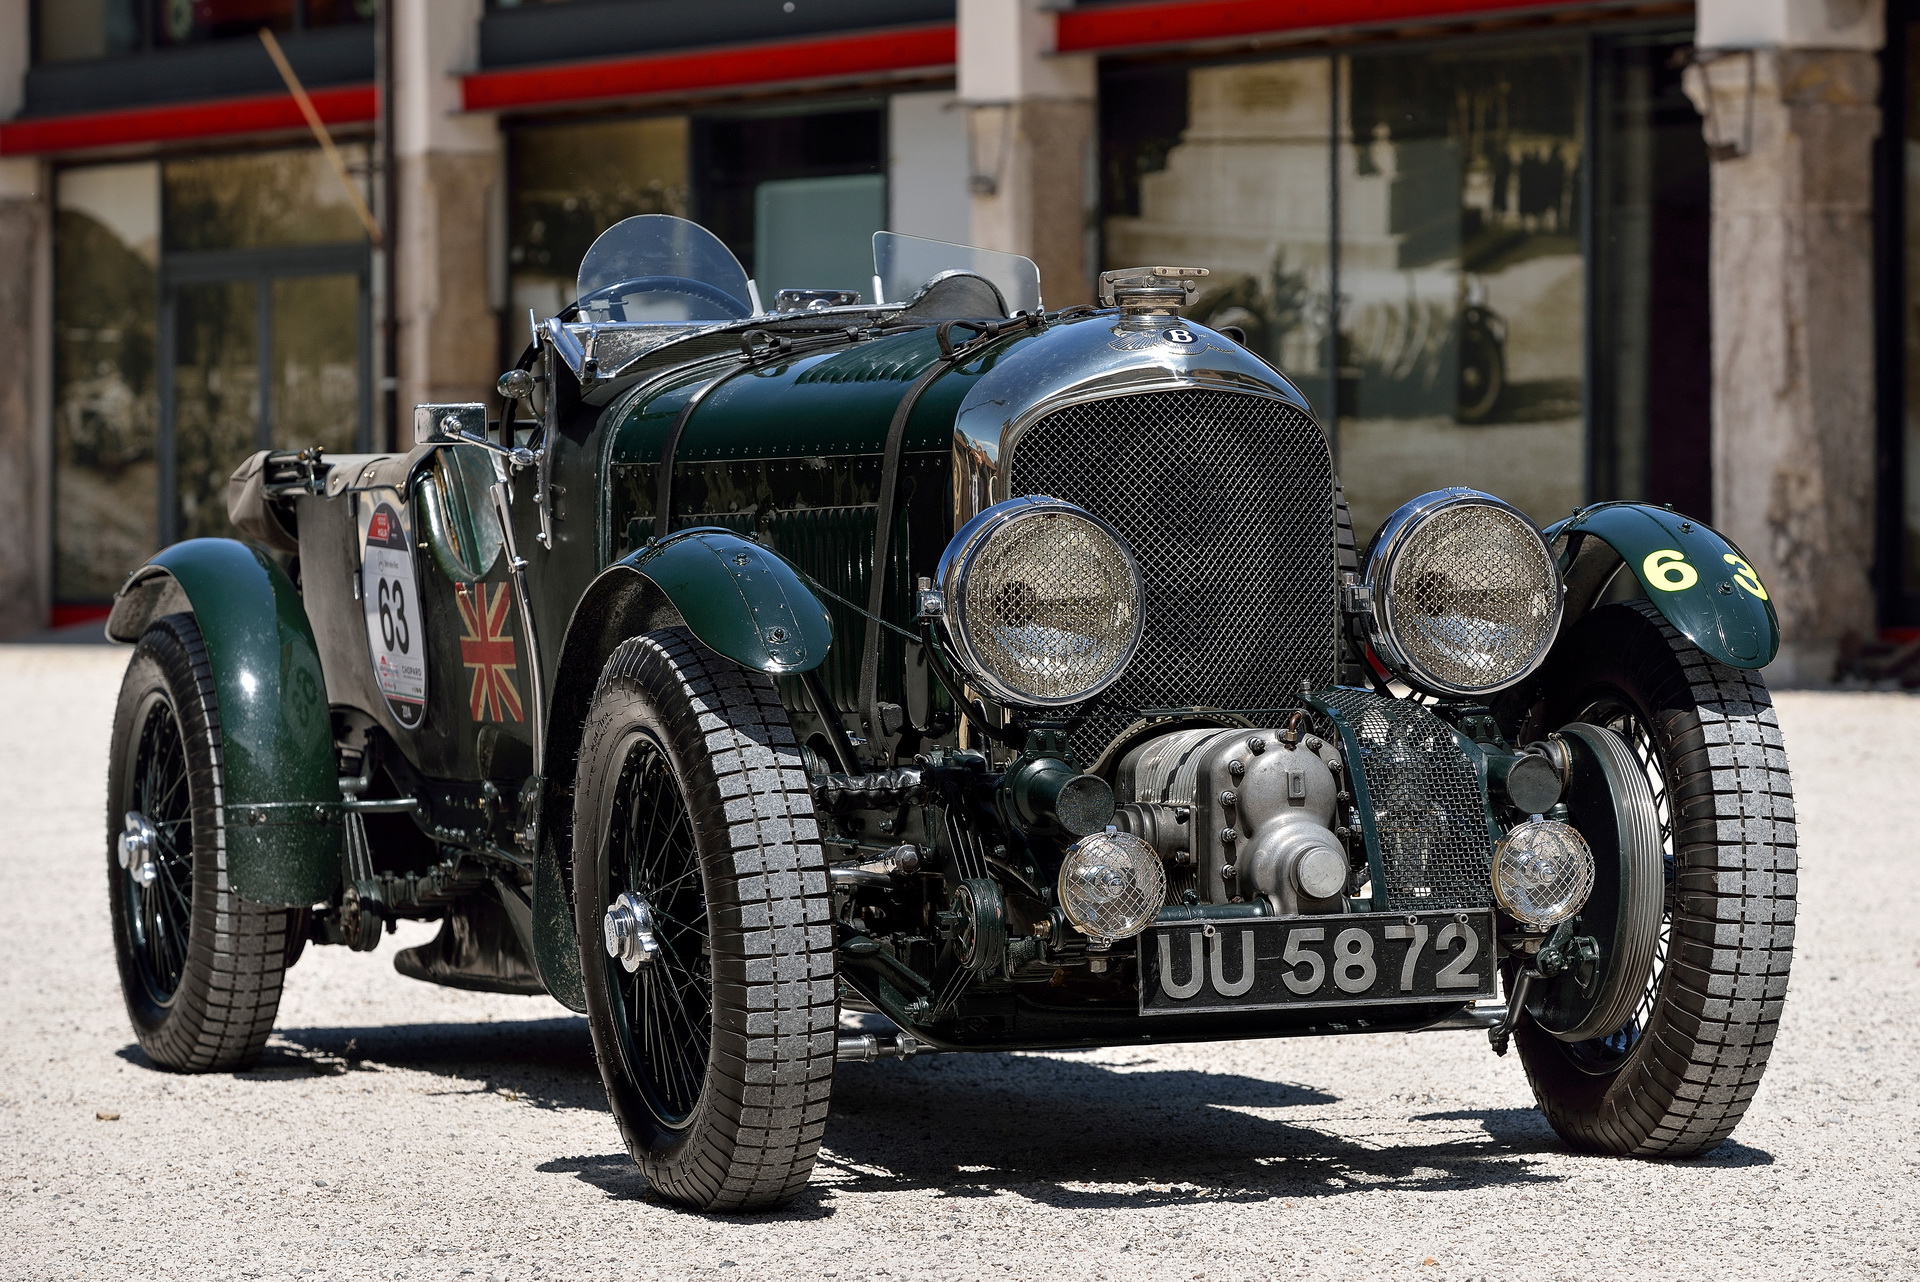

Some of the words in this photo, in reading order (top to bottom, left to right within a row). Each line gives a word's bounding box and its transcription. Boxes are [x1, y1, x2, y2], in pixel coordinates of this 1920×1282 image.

[1169, 329, 1193, 343] B
[378, 577, 409, 655] 63
[1158, 930, 1255, 999] UU
[1282, 923, 1479, 995] 5872
